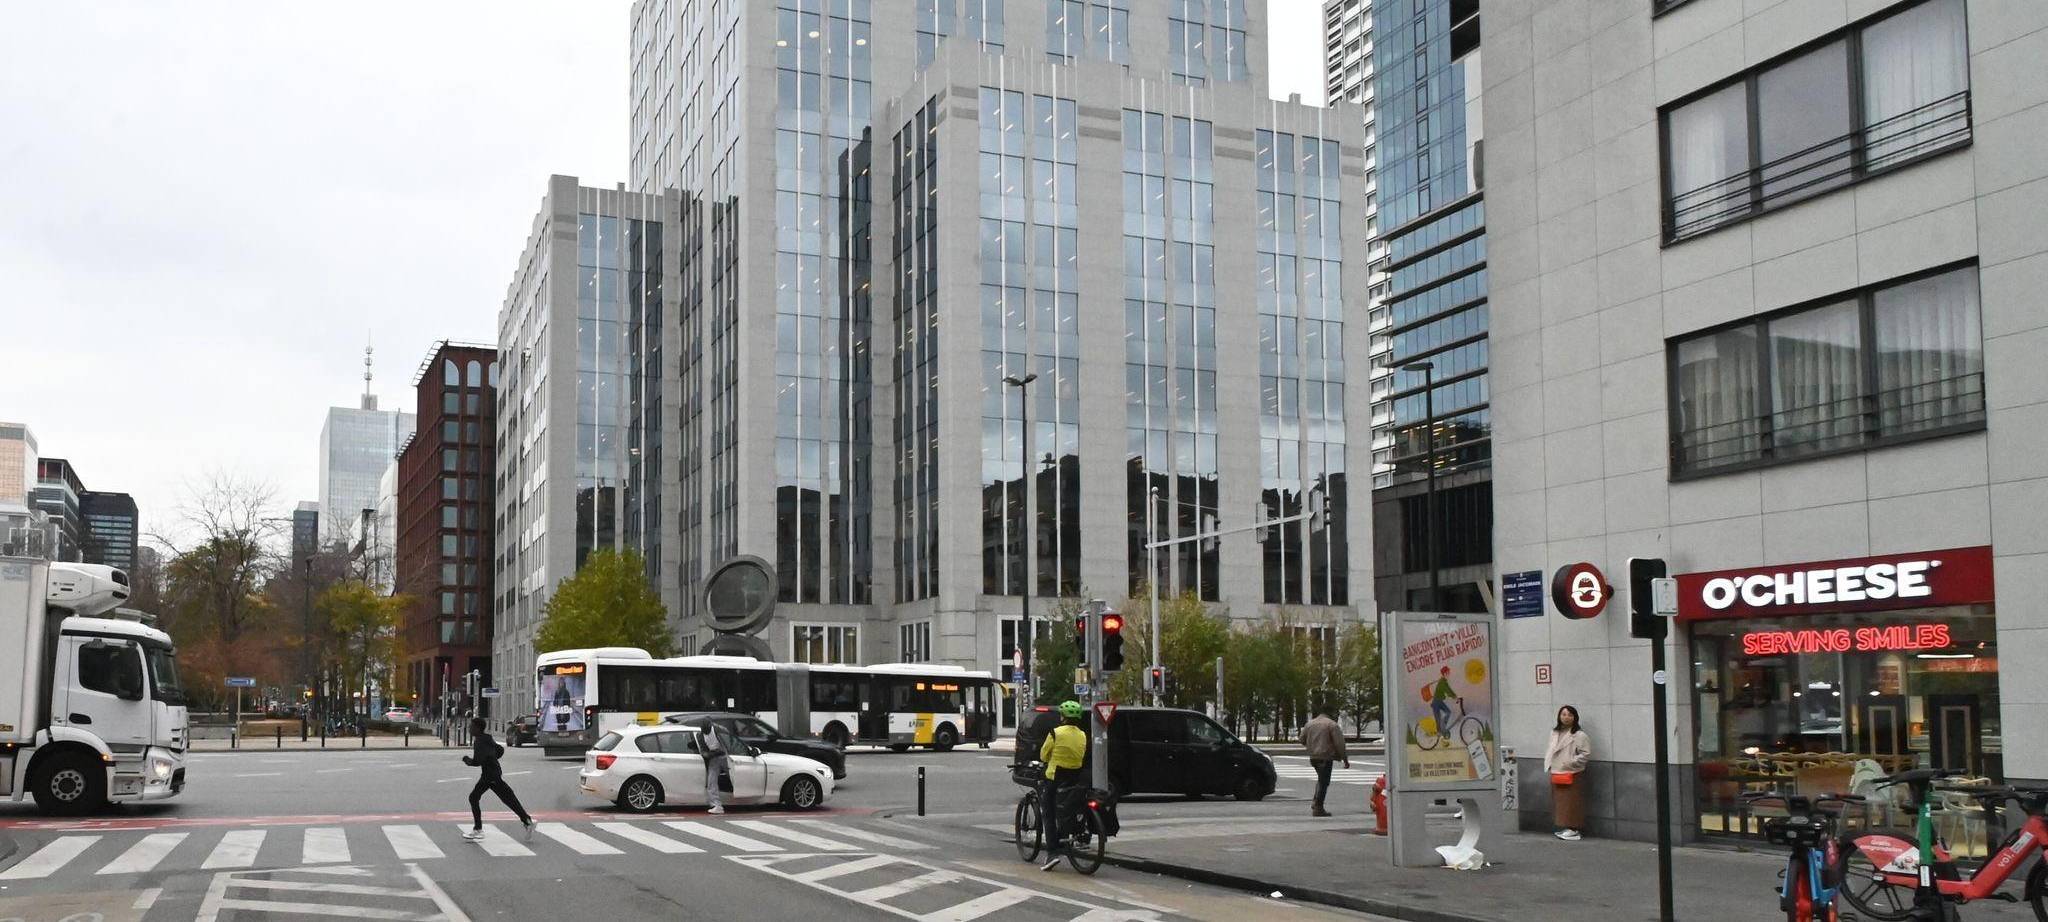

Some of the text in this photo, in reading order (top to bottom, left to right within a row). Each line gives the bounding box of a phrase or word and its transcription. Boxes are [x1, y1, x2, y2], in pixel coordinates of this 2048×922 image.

[1702, 560, 1932, 610] O'CHEESE
[1403, 632, 1449, 660] BANCONTACT
[1743, 624, 1950, 655] SERVING SMILES
[1406, 653, 1435, 673] ENCORE
[1436, 646, 1455, 663] PLUS
